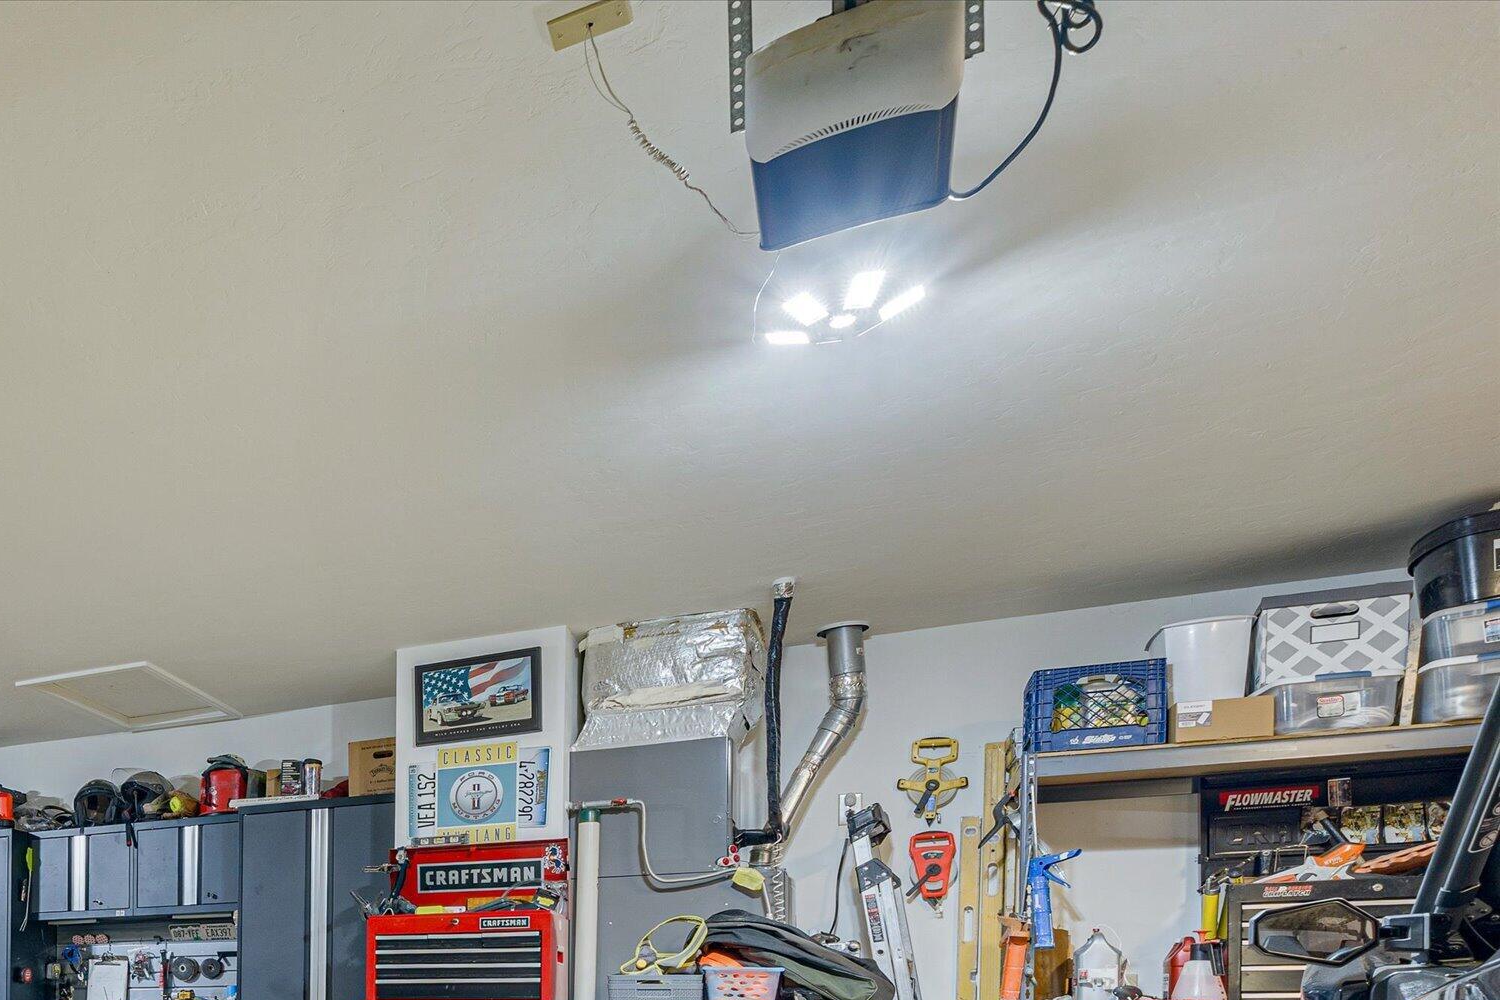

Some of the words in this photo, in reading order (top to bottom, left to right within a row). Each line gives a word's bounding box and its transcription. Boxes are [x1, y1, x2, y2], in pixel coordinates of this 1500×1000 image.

[443, 745, 512, 765] CLASSIC
[460, 771, 495, 781] FORD
[452, 799, 501, 820] MUSTANG
[1224, 789, 1314, 812] FLOWMASTER
[417, 802, 436, 829] VEA
[425, 865, 535, 886] CRAFTSMAN
[482, 917, 527, 927] CRAFTSMAN
